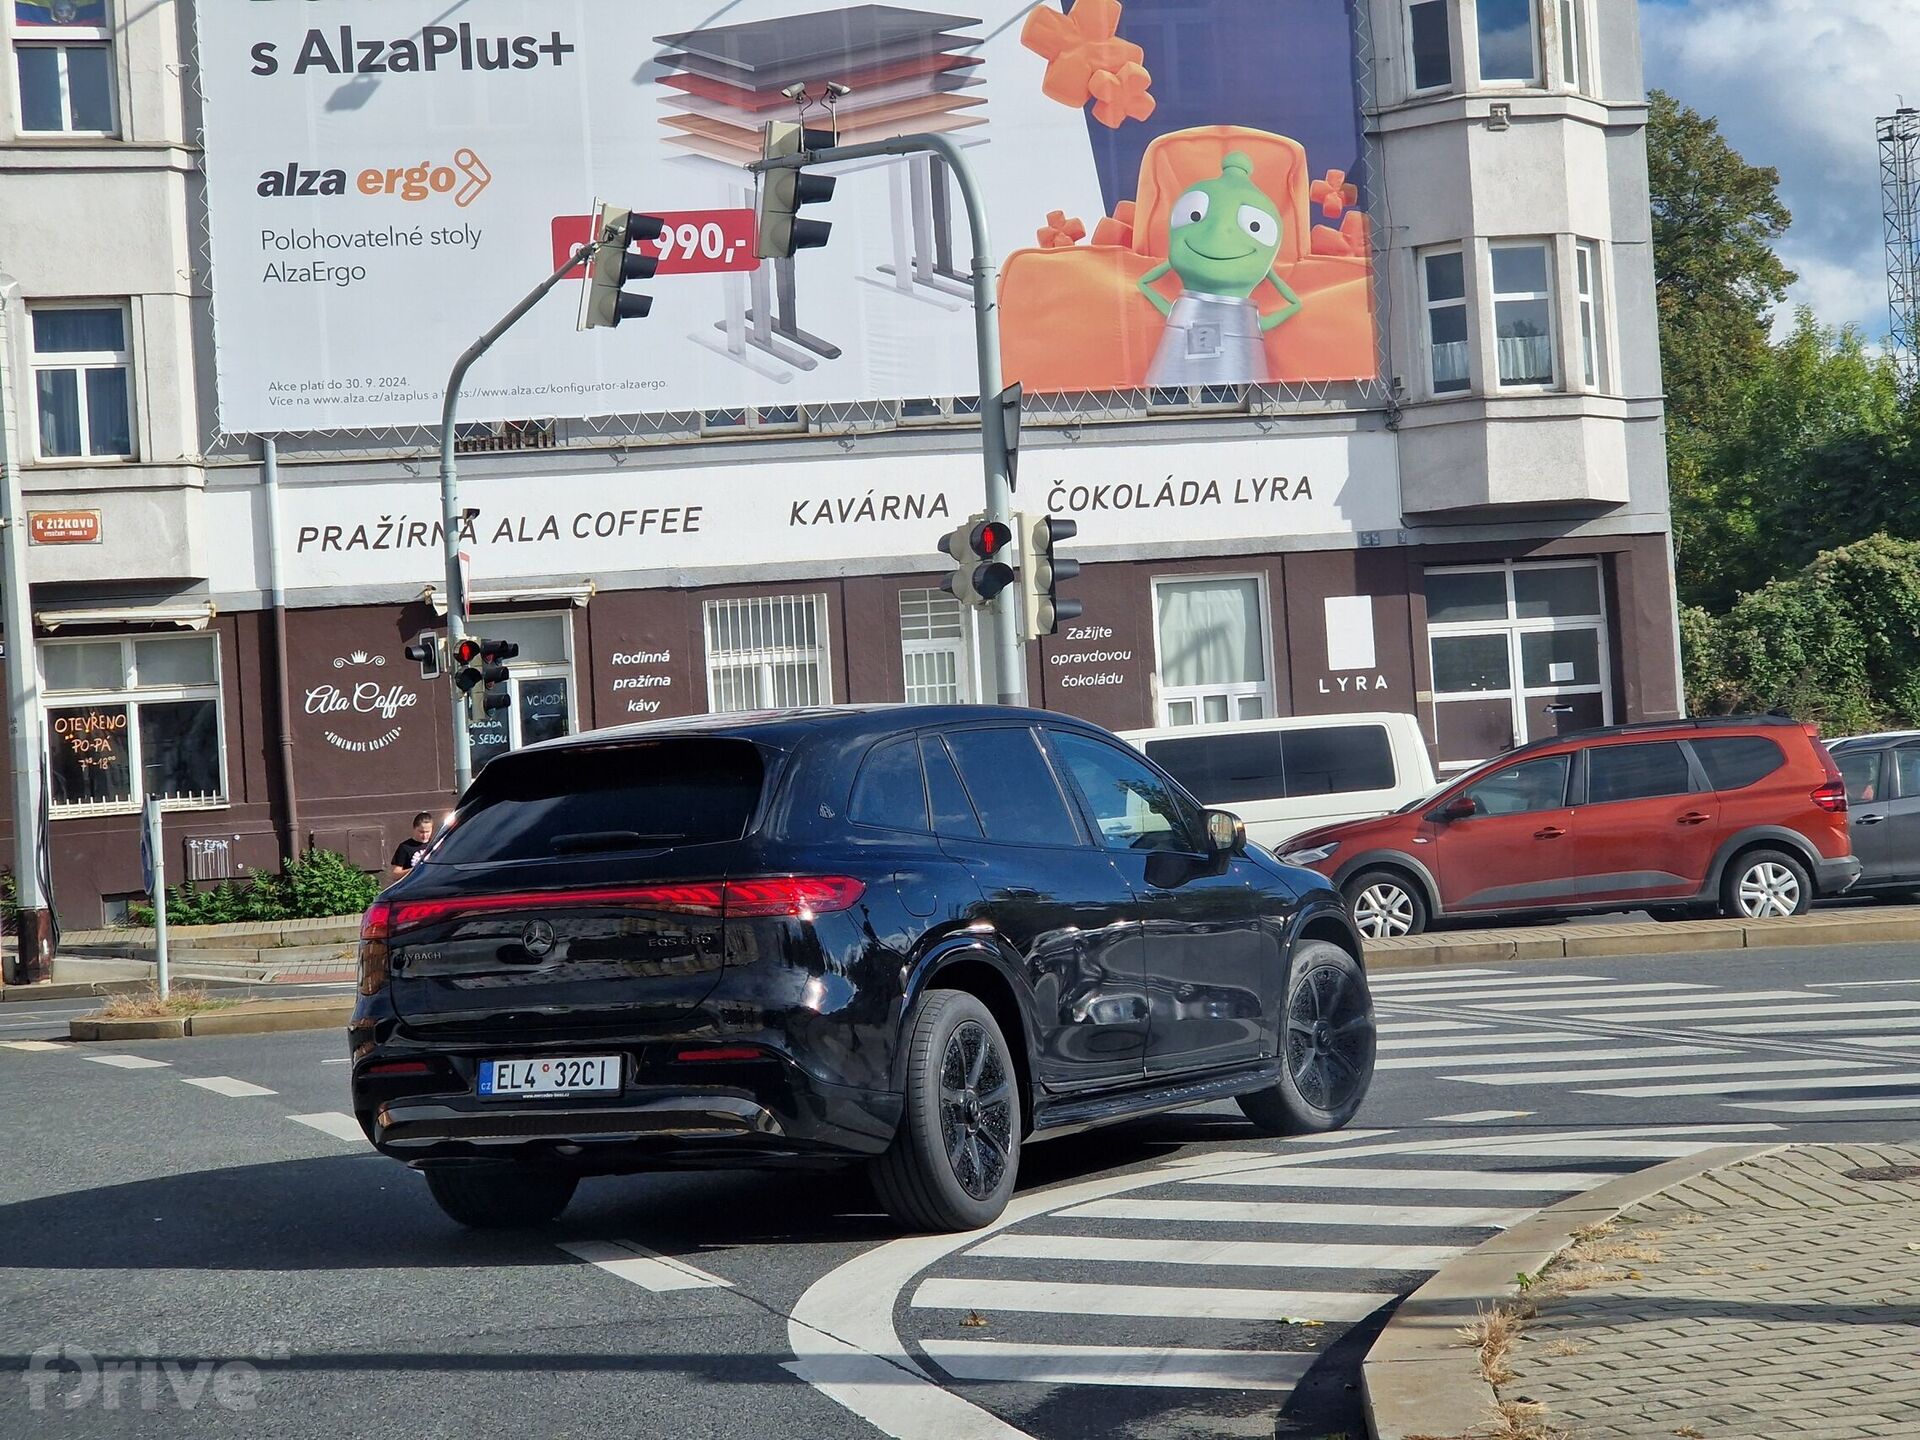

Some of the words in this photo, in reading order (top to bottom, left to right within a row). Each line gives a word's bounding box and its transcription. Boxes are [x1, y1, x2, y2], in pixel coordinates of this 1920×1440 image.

[250, 42, 279, 76] s
[293, 23, 575, 75] AlzaPlus+
[256, 162, 347, 198] alza
[356, 160, 456, 202] ergo
[261, 225, 423, 251] Polohovatelné
[430, 222, 482, 250] stoly
[262, 260, 367, 287] AlzaErgo
[268, 381, 298, 392] Akce
[300, 379, 325, 393] platí
[327, 379, 343, 390] do
[345, 378, 363, 389] 30.
[365, 377, 375, 388] 9.
[378, 376, 410, 388] 2024.
[268, 395, 293, 406] Více
[297, 397, 310, 405] na
[313, 389, 429, 404] www.alza.cz/alzaplus
[432, 391, 439, 400] a
[441, 378, 668, 399] hps://www.alza.cz/konfigurator-alzaergo.
[1046, 474, 1222, 514] ČOKOLÁDA
[1234, 475, 1314, 505] LYRA
[788, 492, 950, 527] KAVÁRNA
[36, 519, 44, 529] K
[47, 517, 94, 529] ŽIŽKOVU
[297, 514, 478, 553] PRAŽÍRNA
[491, 516, 560, 544] ALA
[572, 506, 703, 539] COFFEE
[1066, 625, 1113, 641] Zažijte
[611, 649, 671, 665] Rodinná
[1050, 648, 1132, 666] opravdovou
[612, 674, 672, 691] pražírna
[1061, 671, 1124, 688] čokoládu
[1318, 674, 1389, 694] LYRA
[305, 685, 350, 714] Ala
[353, 682, 417, 719] Coffee
[627, 698, 661, 713] kávy
[54, 711, 126, 733] OTEVŘENO
[72, 735, 112, 753] PO-PÁ
[326, 731, 366, 752] HOMEMADE
[368, 728, 401, 751] ROASTED
[469, 733, 476, 746] S
[478, 733, 508, 745] SEBOU
[402, 951, 442, 961] AYBACH
[480, 1081, 492, 1091] CZ
[496, 1062, 536, 1091] EL4
